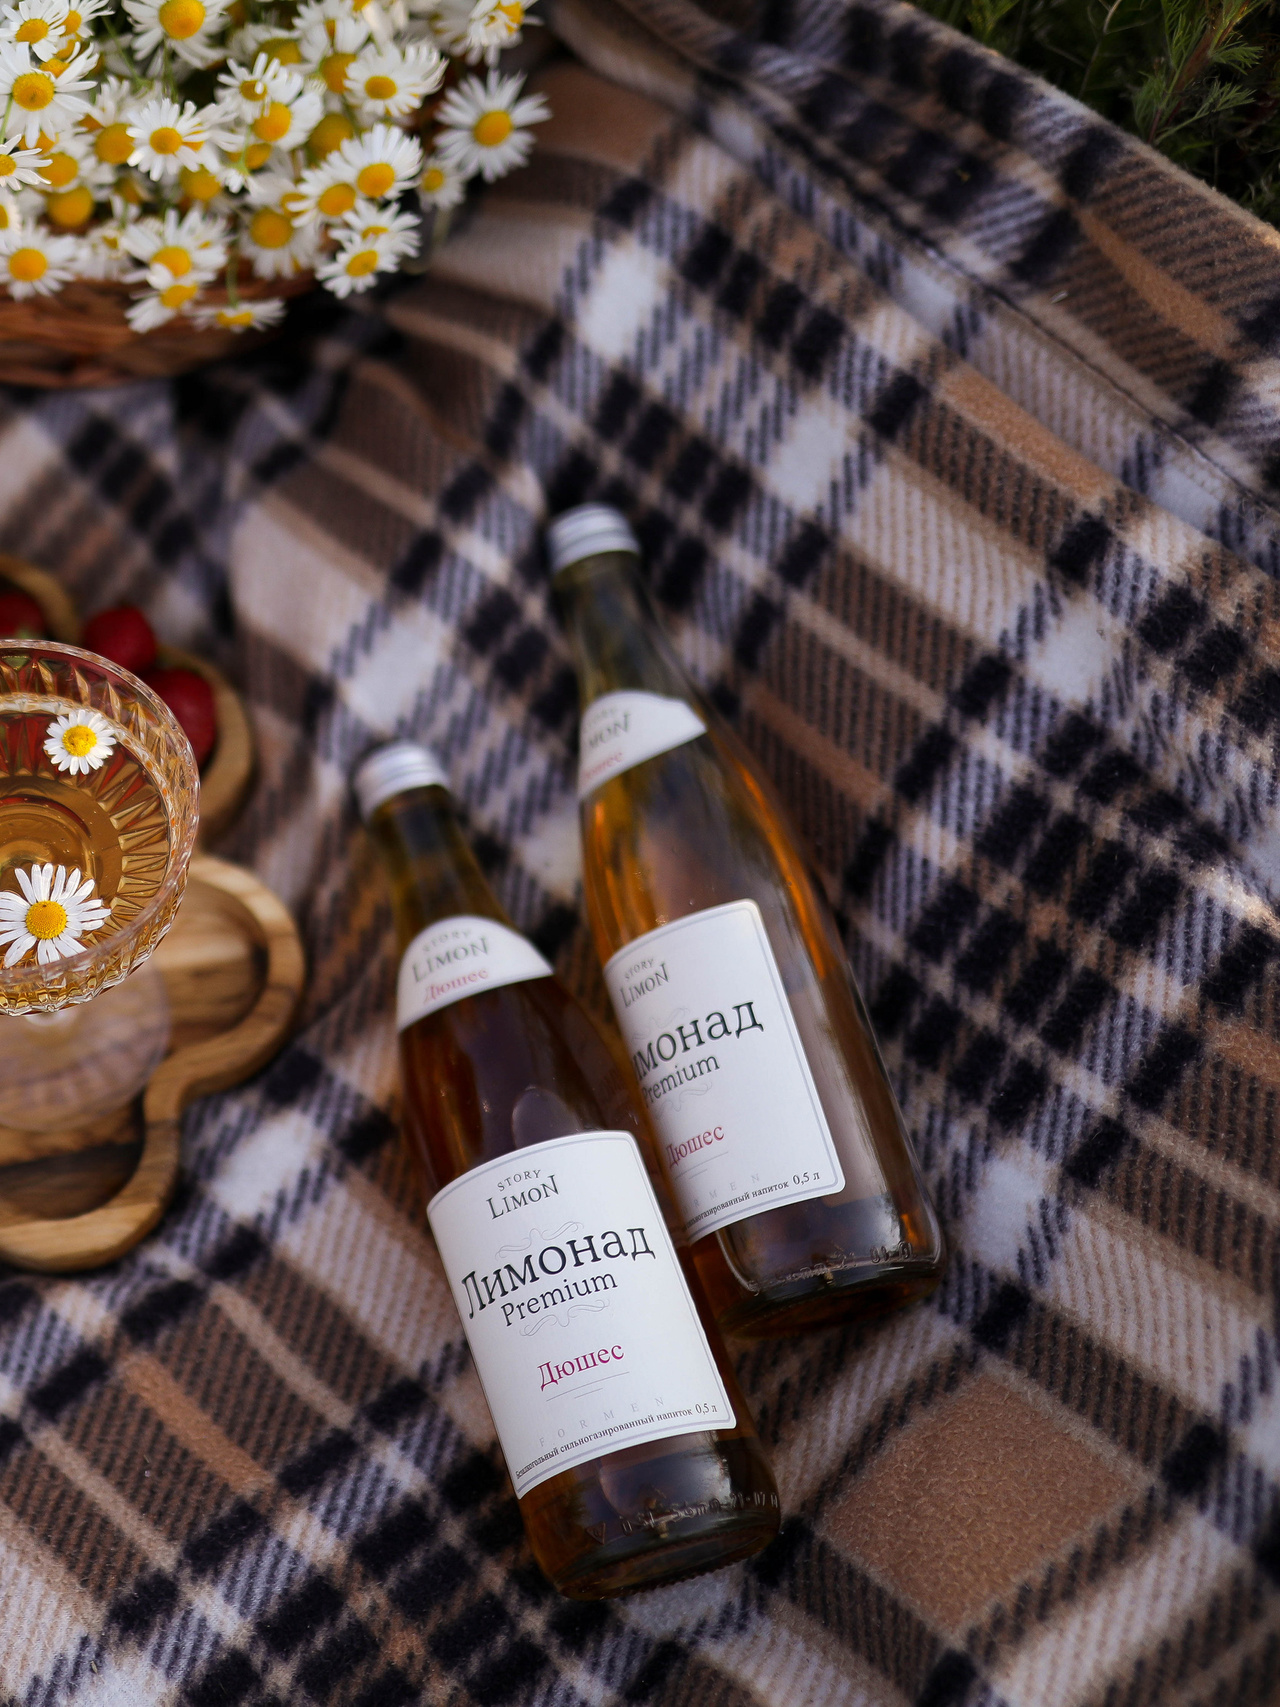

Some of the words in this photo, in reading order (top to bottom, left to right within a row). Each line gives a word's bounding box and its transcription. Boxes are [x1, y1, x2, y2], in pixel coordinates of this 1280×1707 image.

[412, 935, 489, 983] LIMON
[423, 929, 470, 953] STORY
[424, 968, 489, 1005] Дюшес
[619, 962, 670, 1009] LIMON
[624, 957, 656, 982] STORY
[666, 1126, 725, 1169] Дюшес
[486, 1174, 560, 1221] LIMON
[497, 1169, 542, 1192] STORY
[751, 1180, 790, 1199] напиток
[792, 1171, 810, 1187] 0,5
[813, 1171, 821, 1182] л
[461, 1227, 657, 1320] Лимонад
[500, 1272, 619, 1328] Premium
[537, 1344, 626, 1393] Дюшес
[560, 1414, 655, 1453] сильногазированный
[656, 1407, 693, 1423] напиток
[695, 1402, 710, 1416] 0,5
[711, 1403, 718, 1414] л
